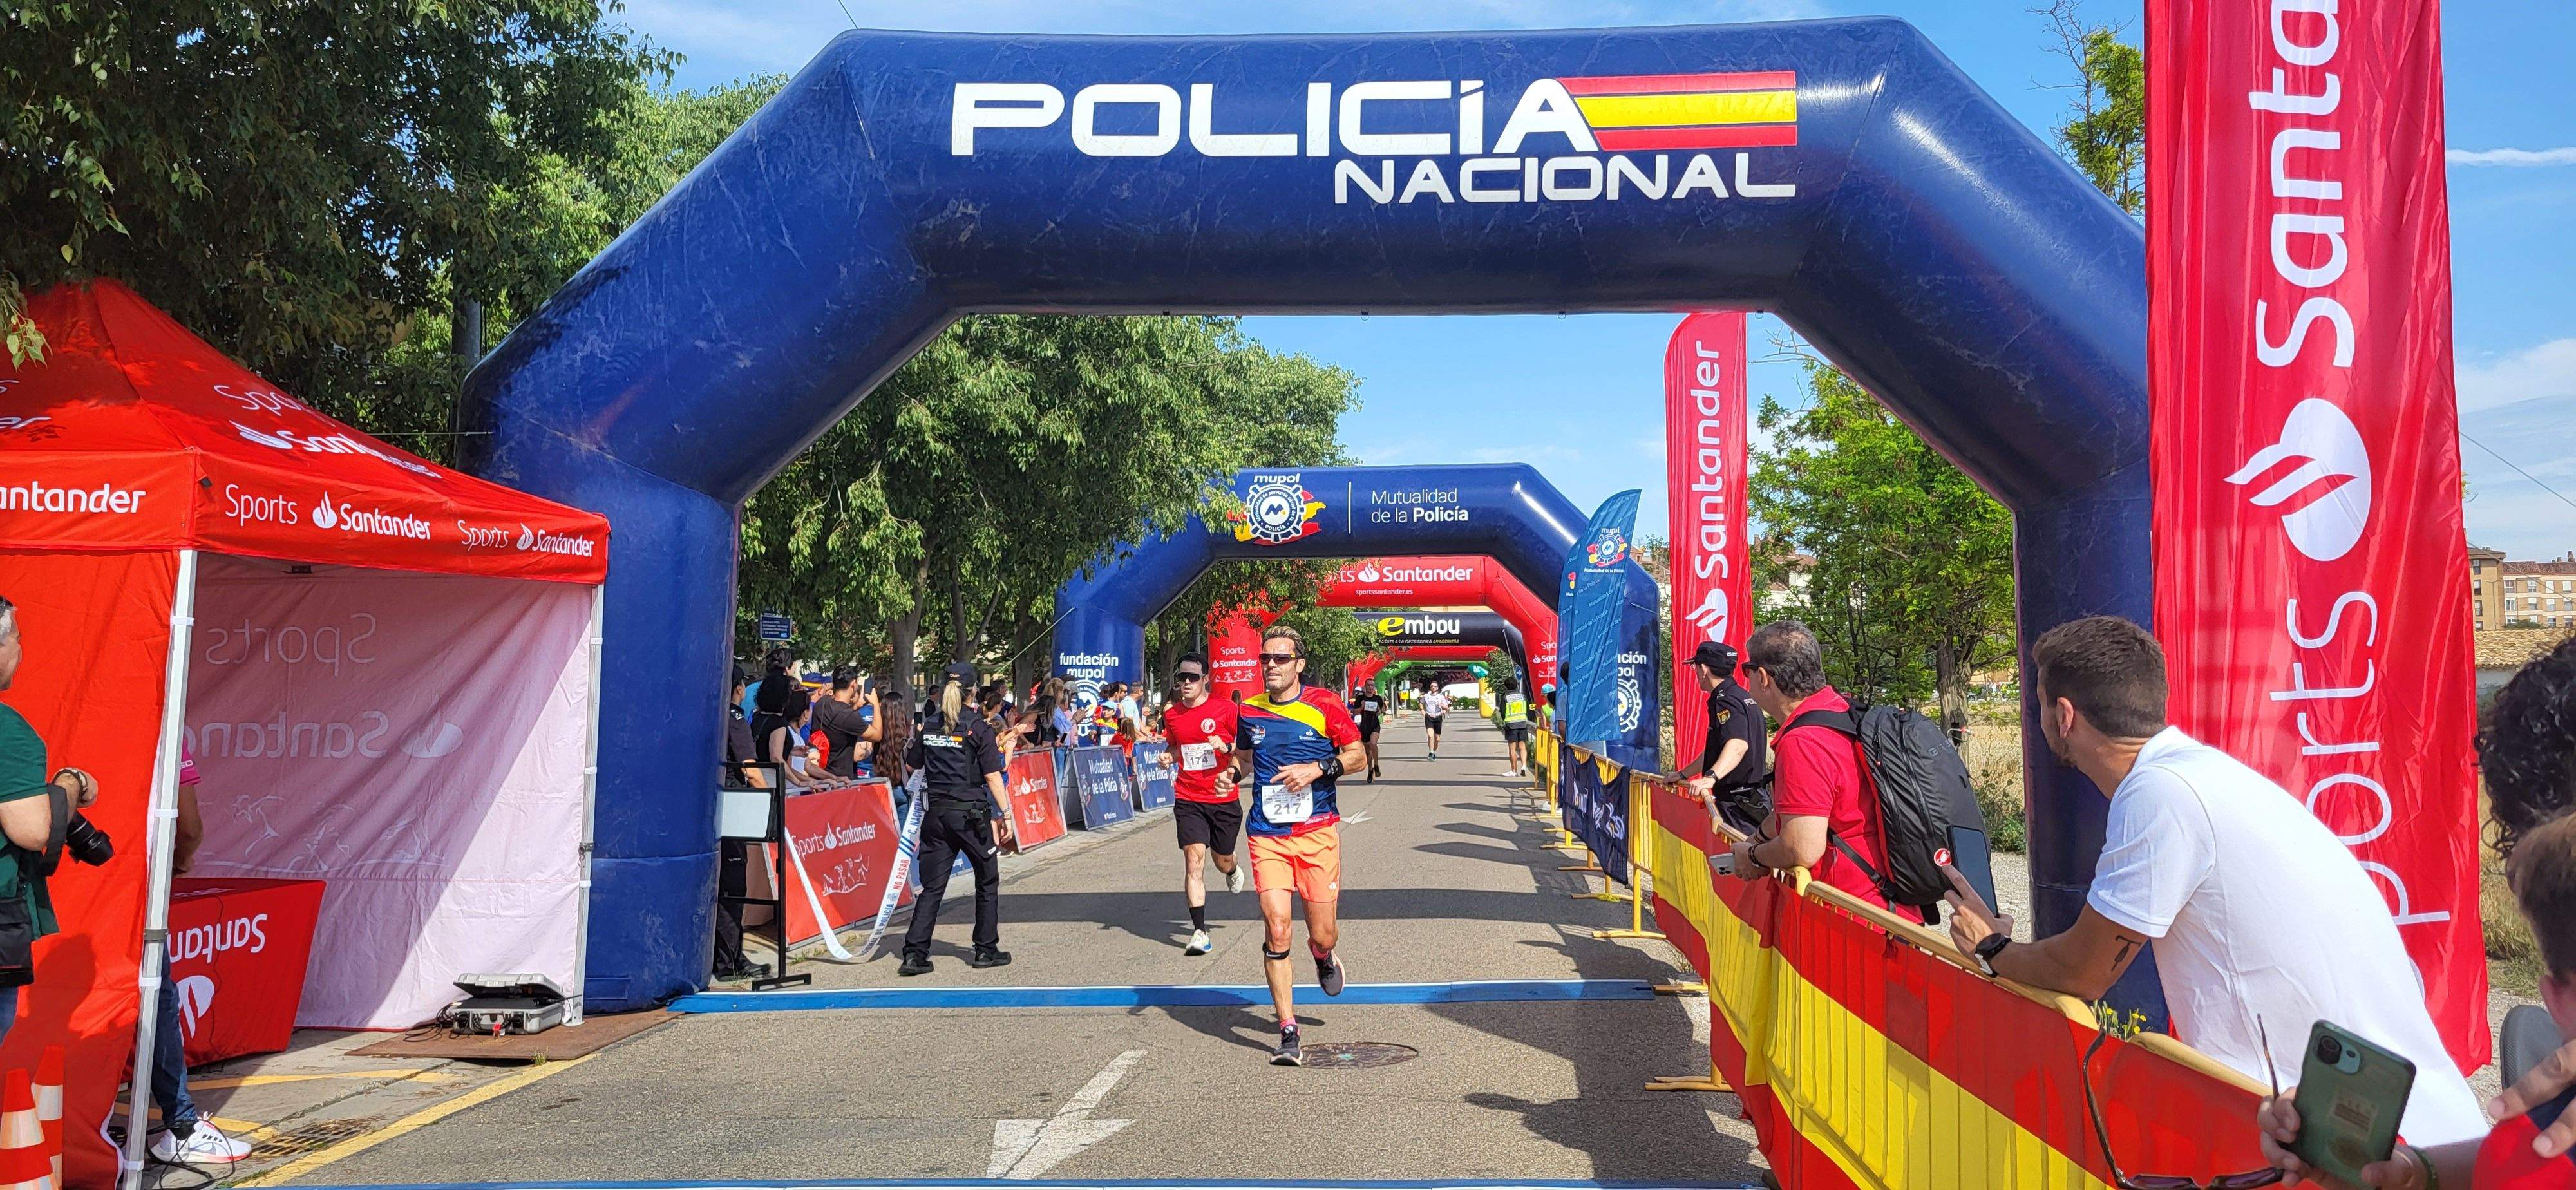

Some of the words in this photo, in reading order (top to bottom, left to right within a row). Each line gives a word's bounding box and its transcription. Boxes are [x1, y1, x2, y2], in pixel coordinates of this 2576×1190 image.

[1335, 152, 1796, 204] NACIONAL
[1690, 340, 1728, 580] Santander
[1254, 473, 1300, 484] mupol
[1372, 488, 1457, 504] Mutualidad
[225, 484, 298, 526] Sports
[340, 504, 431, 540] Santander
[1371, 507, 1390, 522] de
[1396, 507, 1408, 522] la
[1413, 506, 1469, 522] Policía
[457, 520, 509, 552] Sports
[532, 529, 594, 557] Santander
[1382, 565, 1473, 583] Santander
[1355, 587, 1414, 596] sportssantander.es
[1377, 615, 1460, 636] embou
[1059, 652, 1119, 666] fundación
[1220, 647, 1246, 656] Sports
[1219, 658, 1258, 668] Santander
[1066, 665, 1105, 680] mupol
[1088, 757, 1113, 775] Mutualidad
[1190, 755, 1209, 765] 174
[1092, 779, 1099, 795] de
[2270, 591, 2450, 1001] ports
[1274, 802, 1302, 815] 217
[791, 833, 825, 861] Sports
[836, 821, 876, 847] Santander
[896, 858, 910, 880] PASAR
[893, 880, 903, 891] NO
